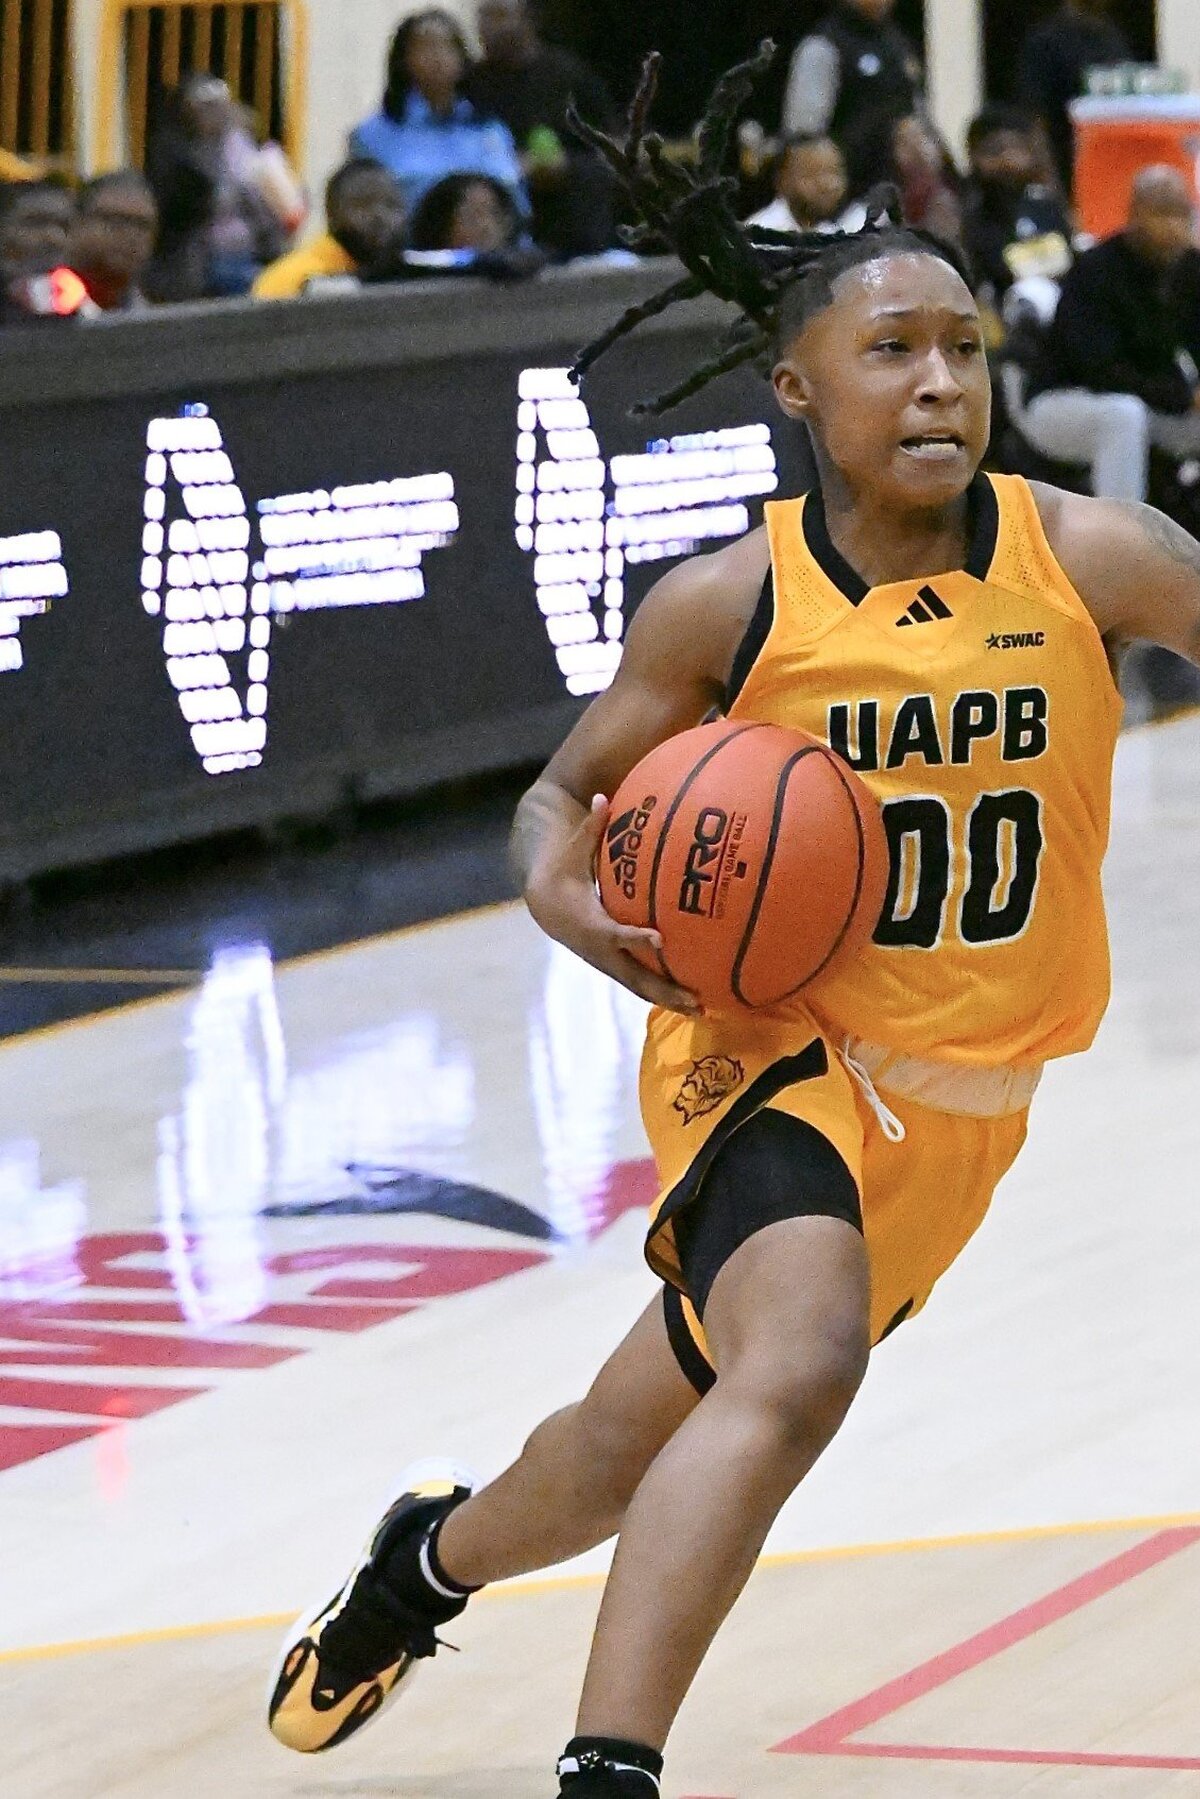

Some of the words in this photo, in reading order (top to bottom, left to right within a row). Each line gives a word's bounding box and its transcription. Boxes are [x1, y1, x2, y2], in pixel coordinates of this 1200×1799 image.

[1002, 632, 1045, 649] SWAC
[826, 685, 1051, 775] UAPB
[621, 796, 657, 900] adidas
[678, 807, 728, 915] PRO
[725, 842, 739, 872] GAME
[732, 815, 748, 842] BALL
[872, 788, 1047, 953] 00
